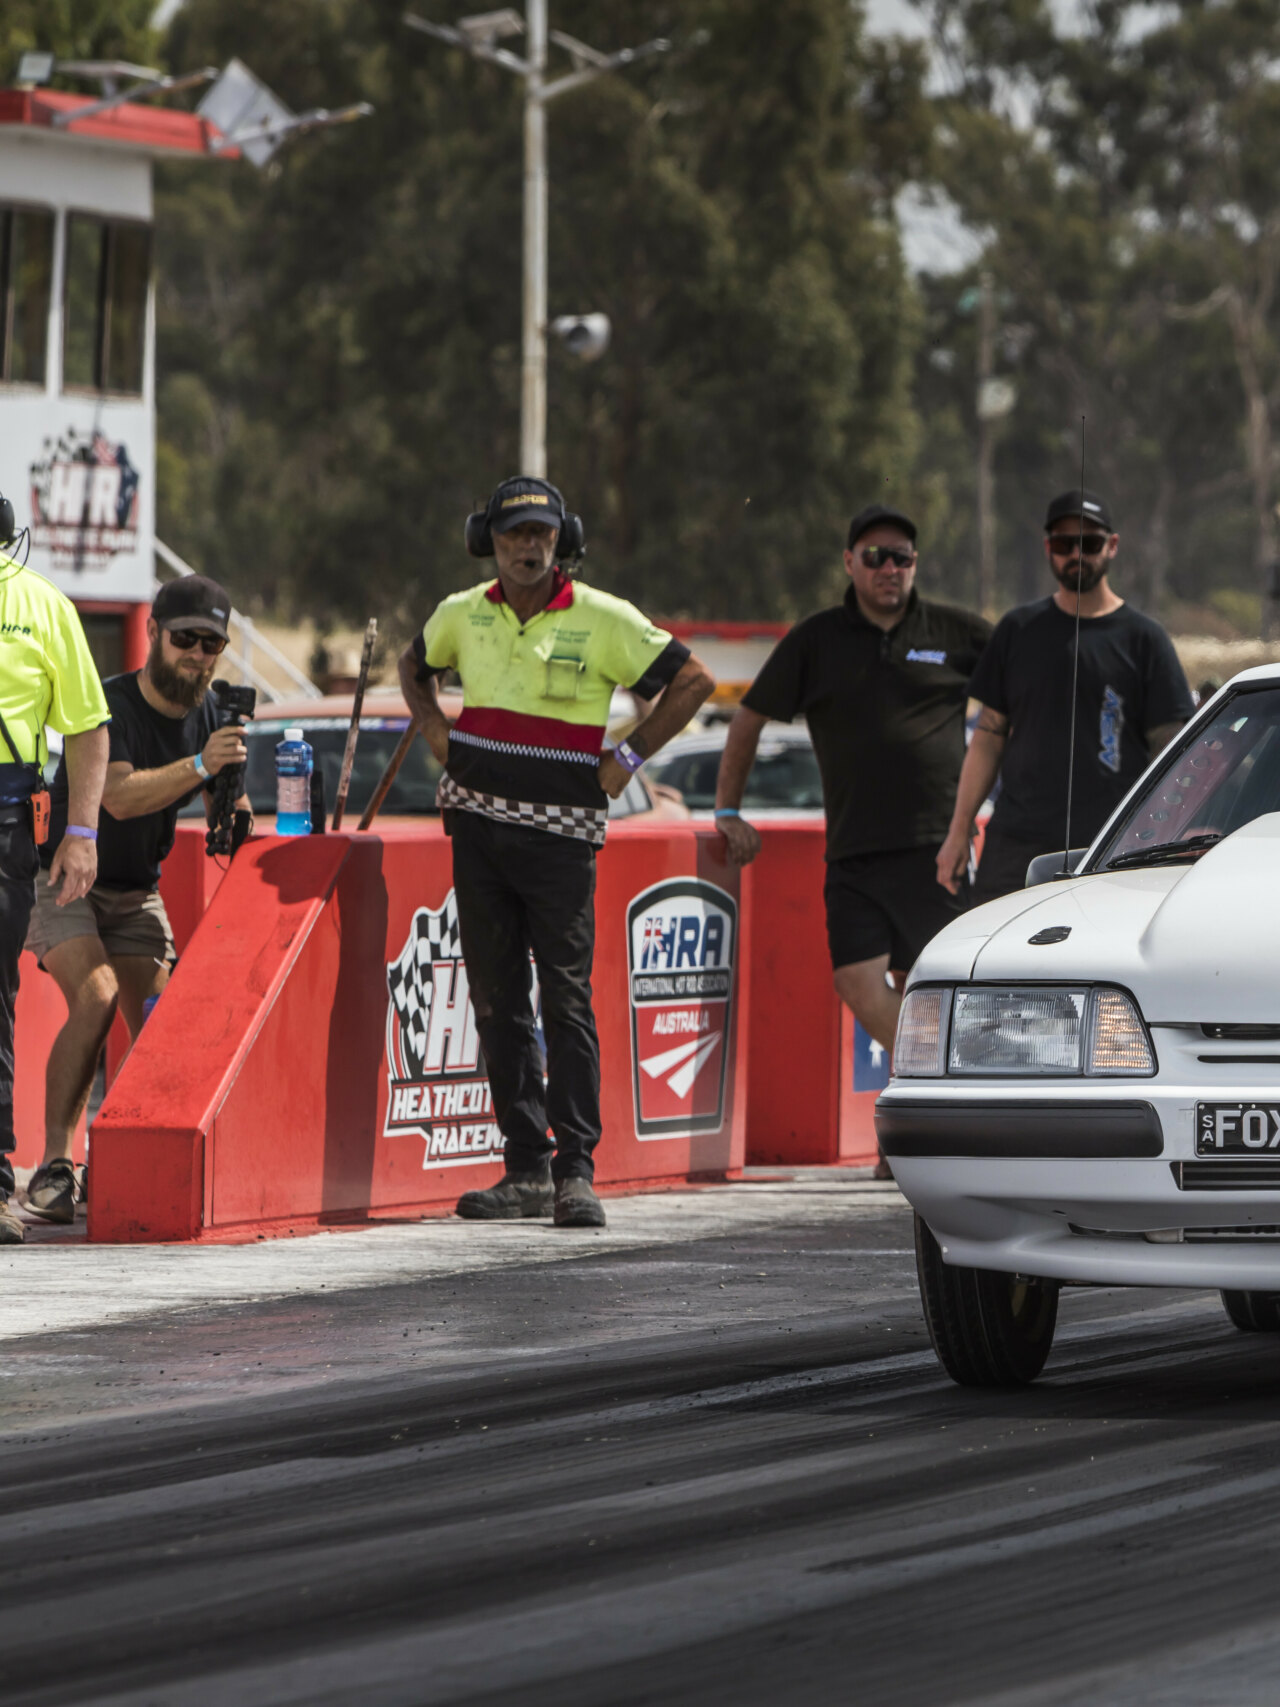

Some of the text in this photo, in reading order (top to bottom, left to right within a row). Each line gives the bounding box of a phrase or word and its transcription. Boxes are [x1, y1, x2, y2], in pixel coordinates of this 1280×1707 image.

[641, 915, 724, 969] IHRA
[652, 1010, 709, 1035] AUSTRALIA
[391, 1081, 491, 1121] HEATHCOT
[430, 1122, 507, 1155] RACEW
